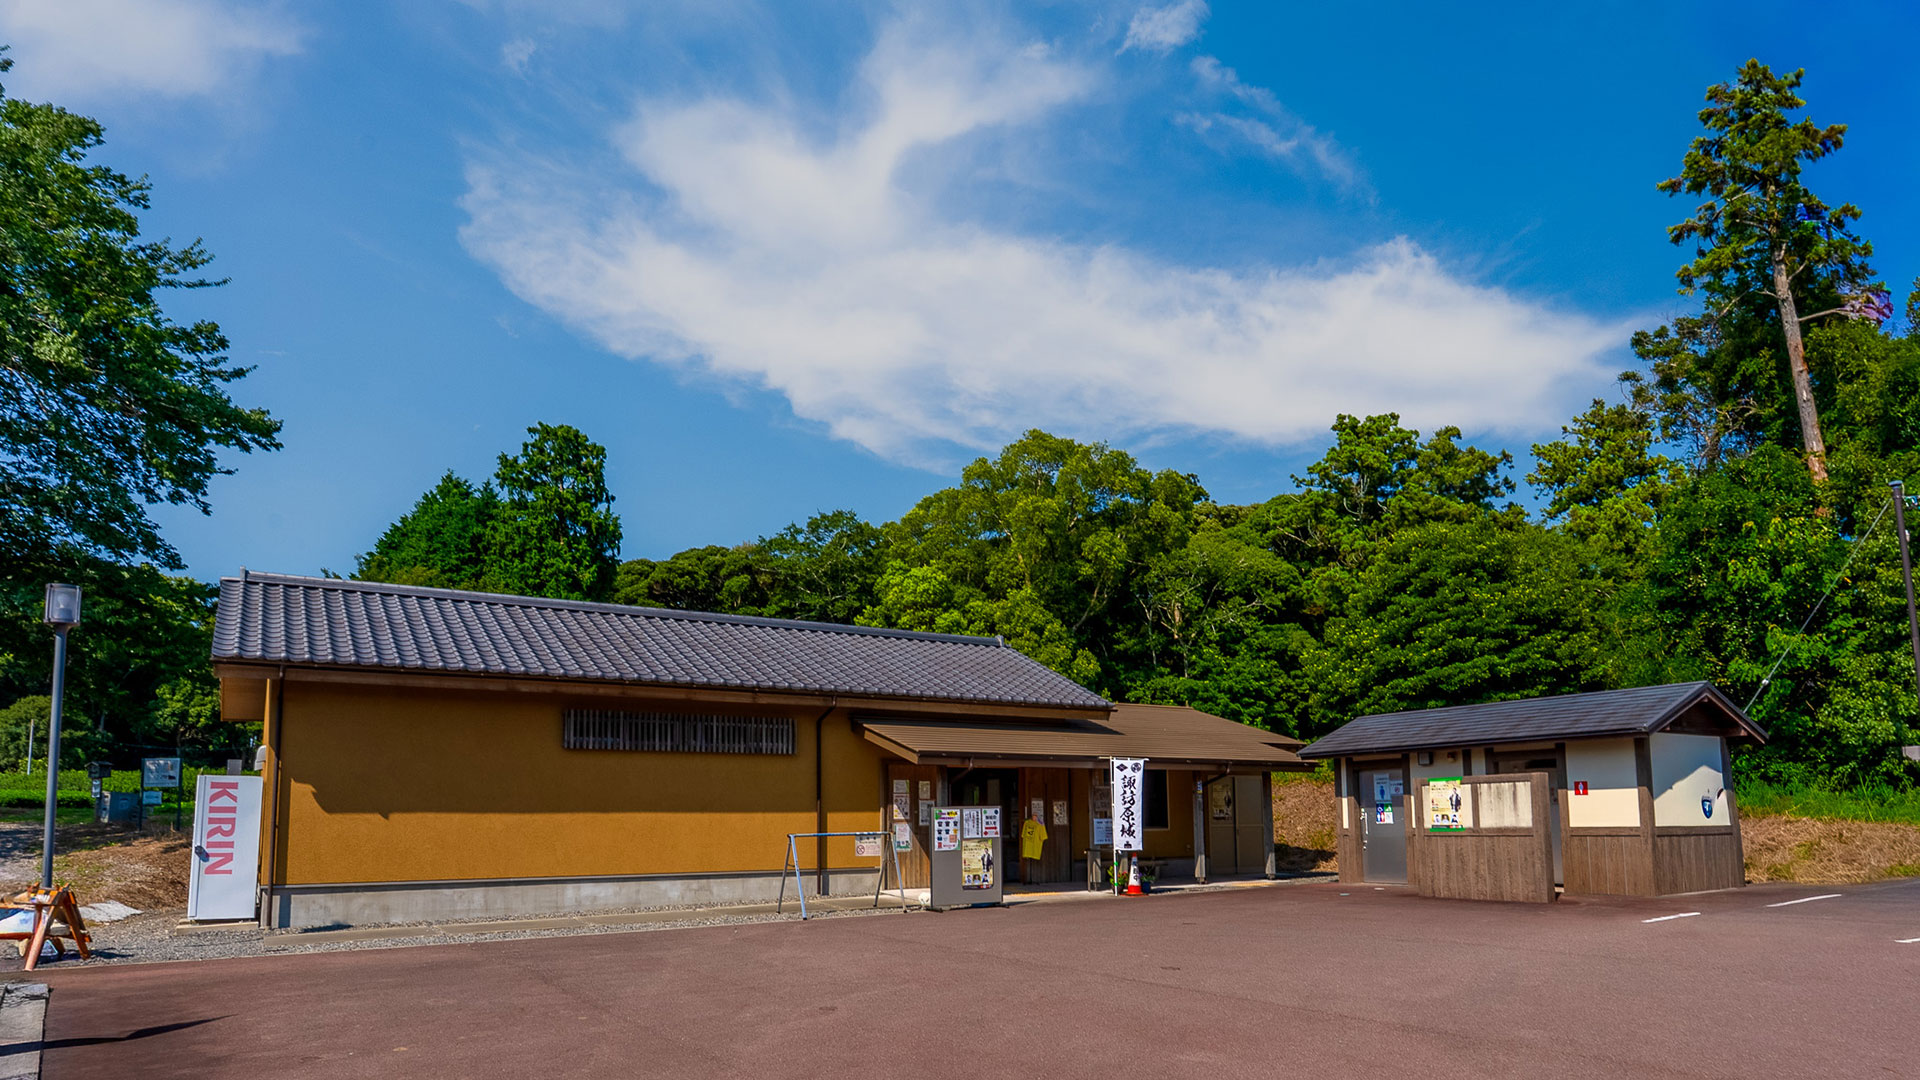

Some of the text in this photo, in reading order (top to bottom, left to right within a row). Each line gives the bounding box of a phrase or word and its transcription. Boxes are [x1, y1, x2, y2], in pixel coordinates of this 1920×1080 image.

[204, 781, 239, 875] KIRIN
[1120, 775, 1136, 838] 諏訪原城
